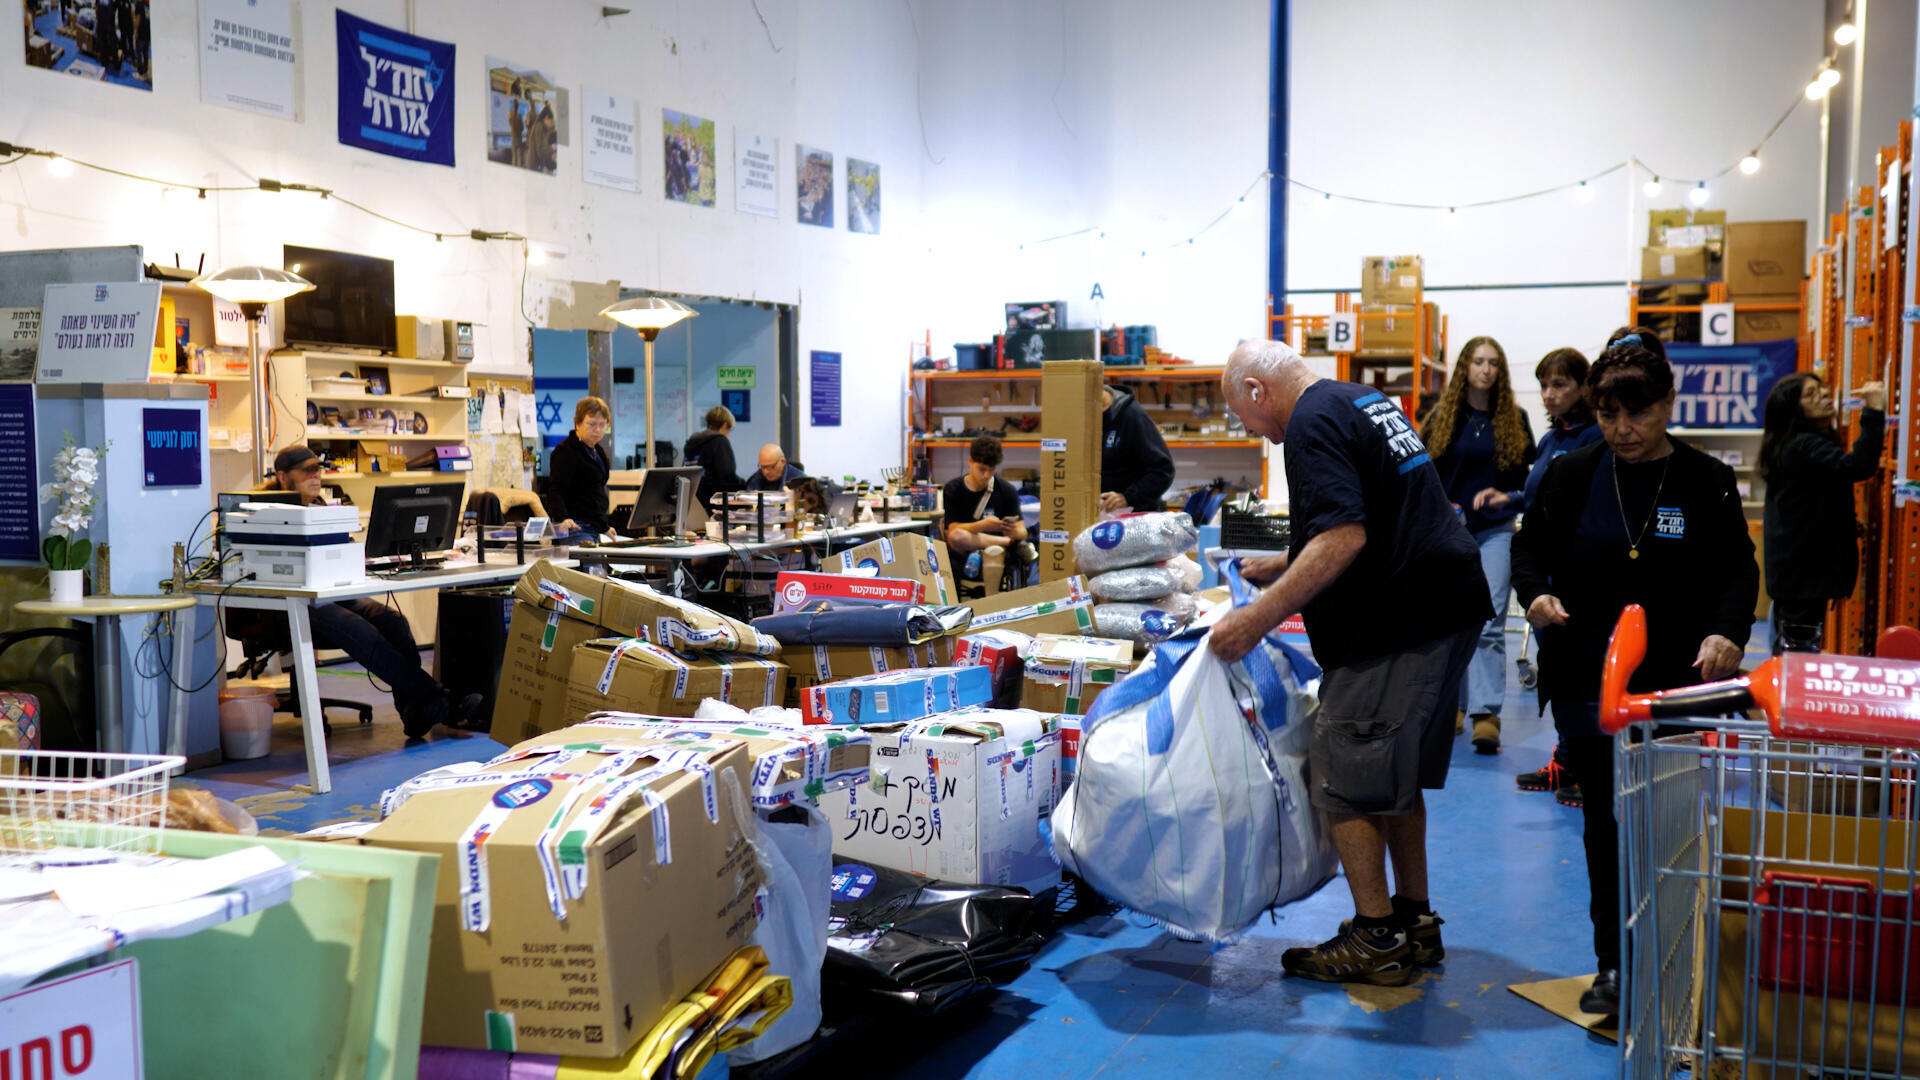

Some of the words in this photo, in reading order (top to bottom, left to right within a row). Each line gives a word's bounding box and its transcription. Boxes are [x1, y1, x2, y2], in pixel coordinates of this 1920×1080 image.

[363, 87, 430, 137] אזרחי
[1089, 283, 1104, 300] A
[60, 315, 88, 330] שאתה
[90, 314, 118, 330] השינוי
[1709, 313, 1728, 335] C
[1334, 321, 1350, 342] B
[85, 332, 111, 349] לראות
[113, 332, 134, 348] רוצה
[1671, 395, 1757, 423] אזרח
[147, 429, 178, 448] לוגיסטי
[180, 431, 198, 450] דסק
[1053, 450, 1066, 491] TENT
[849, 584, 888, 597] קונווקטור
[890, 588, 908, 597] תנור
[1804, 662, 1860, 681] לוי
[1804, 678, 1906, 698] השקמה
[1804, 700, 1860, 715] במדינה
[568, 958, 596, 969] Case
[561, 973, 587, 983] Pack
[590, 973, 598, 982] 2
[568, 987, 599, 997] Israel
[499, 998, 519, 1009] Box
[521, 999, 543, 1010] Tool
[547, 1001, 600, 1011] PACKOUT
